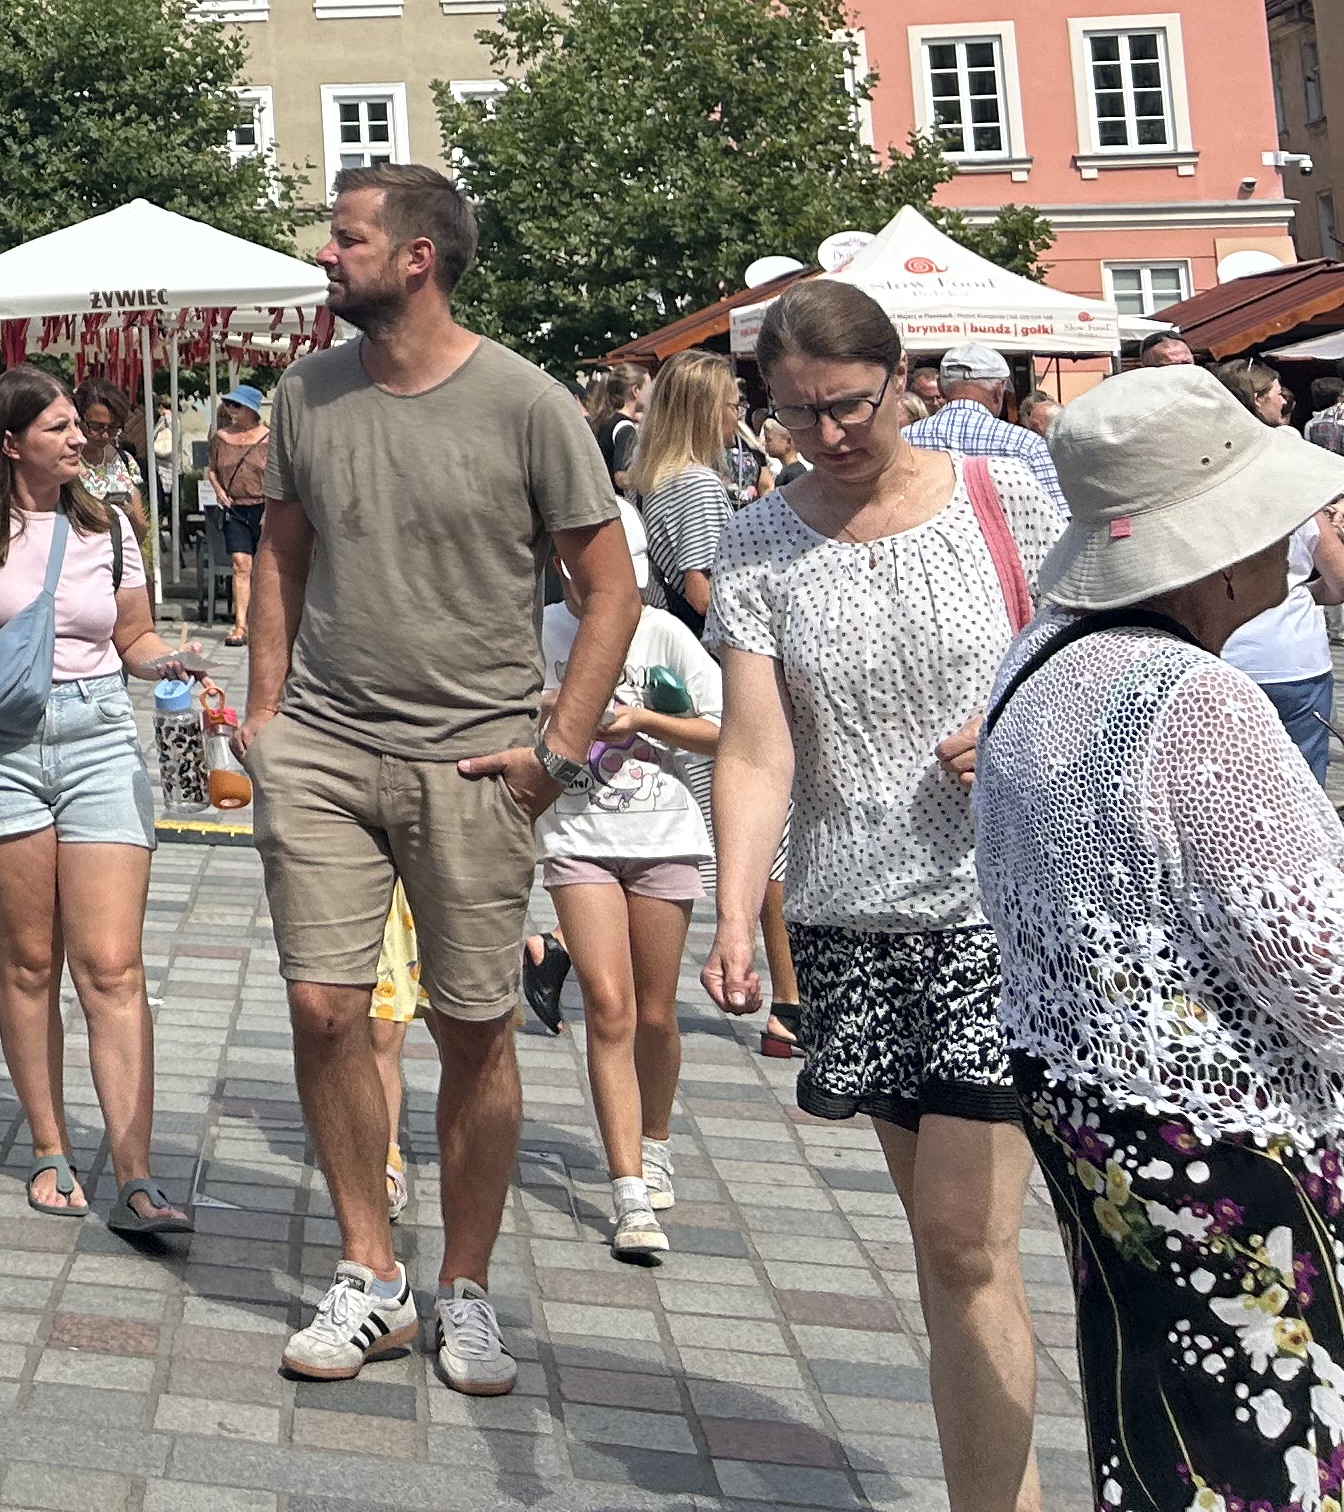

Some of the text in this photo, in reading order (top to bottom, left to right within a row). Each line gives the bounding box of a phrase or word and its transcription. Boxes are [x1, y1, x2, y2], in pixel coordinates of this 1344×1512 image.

[89, 288, 169, 309] ŻYWIEC
[907, 323, 960, 336] bryndza
[970, 323, 1011, 335] bundz
